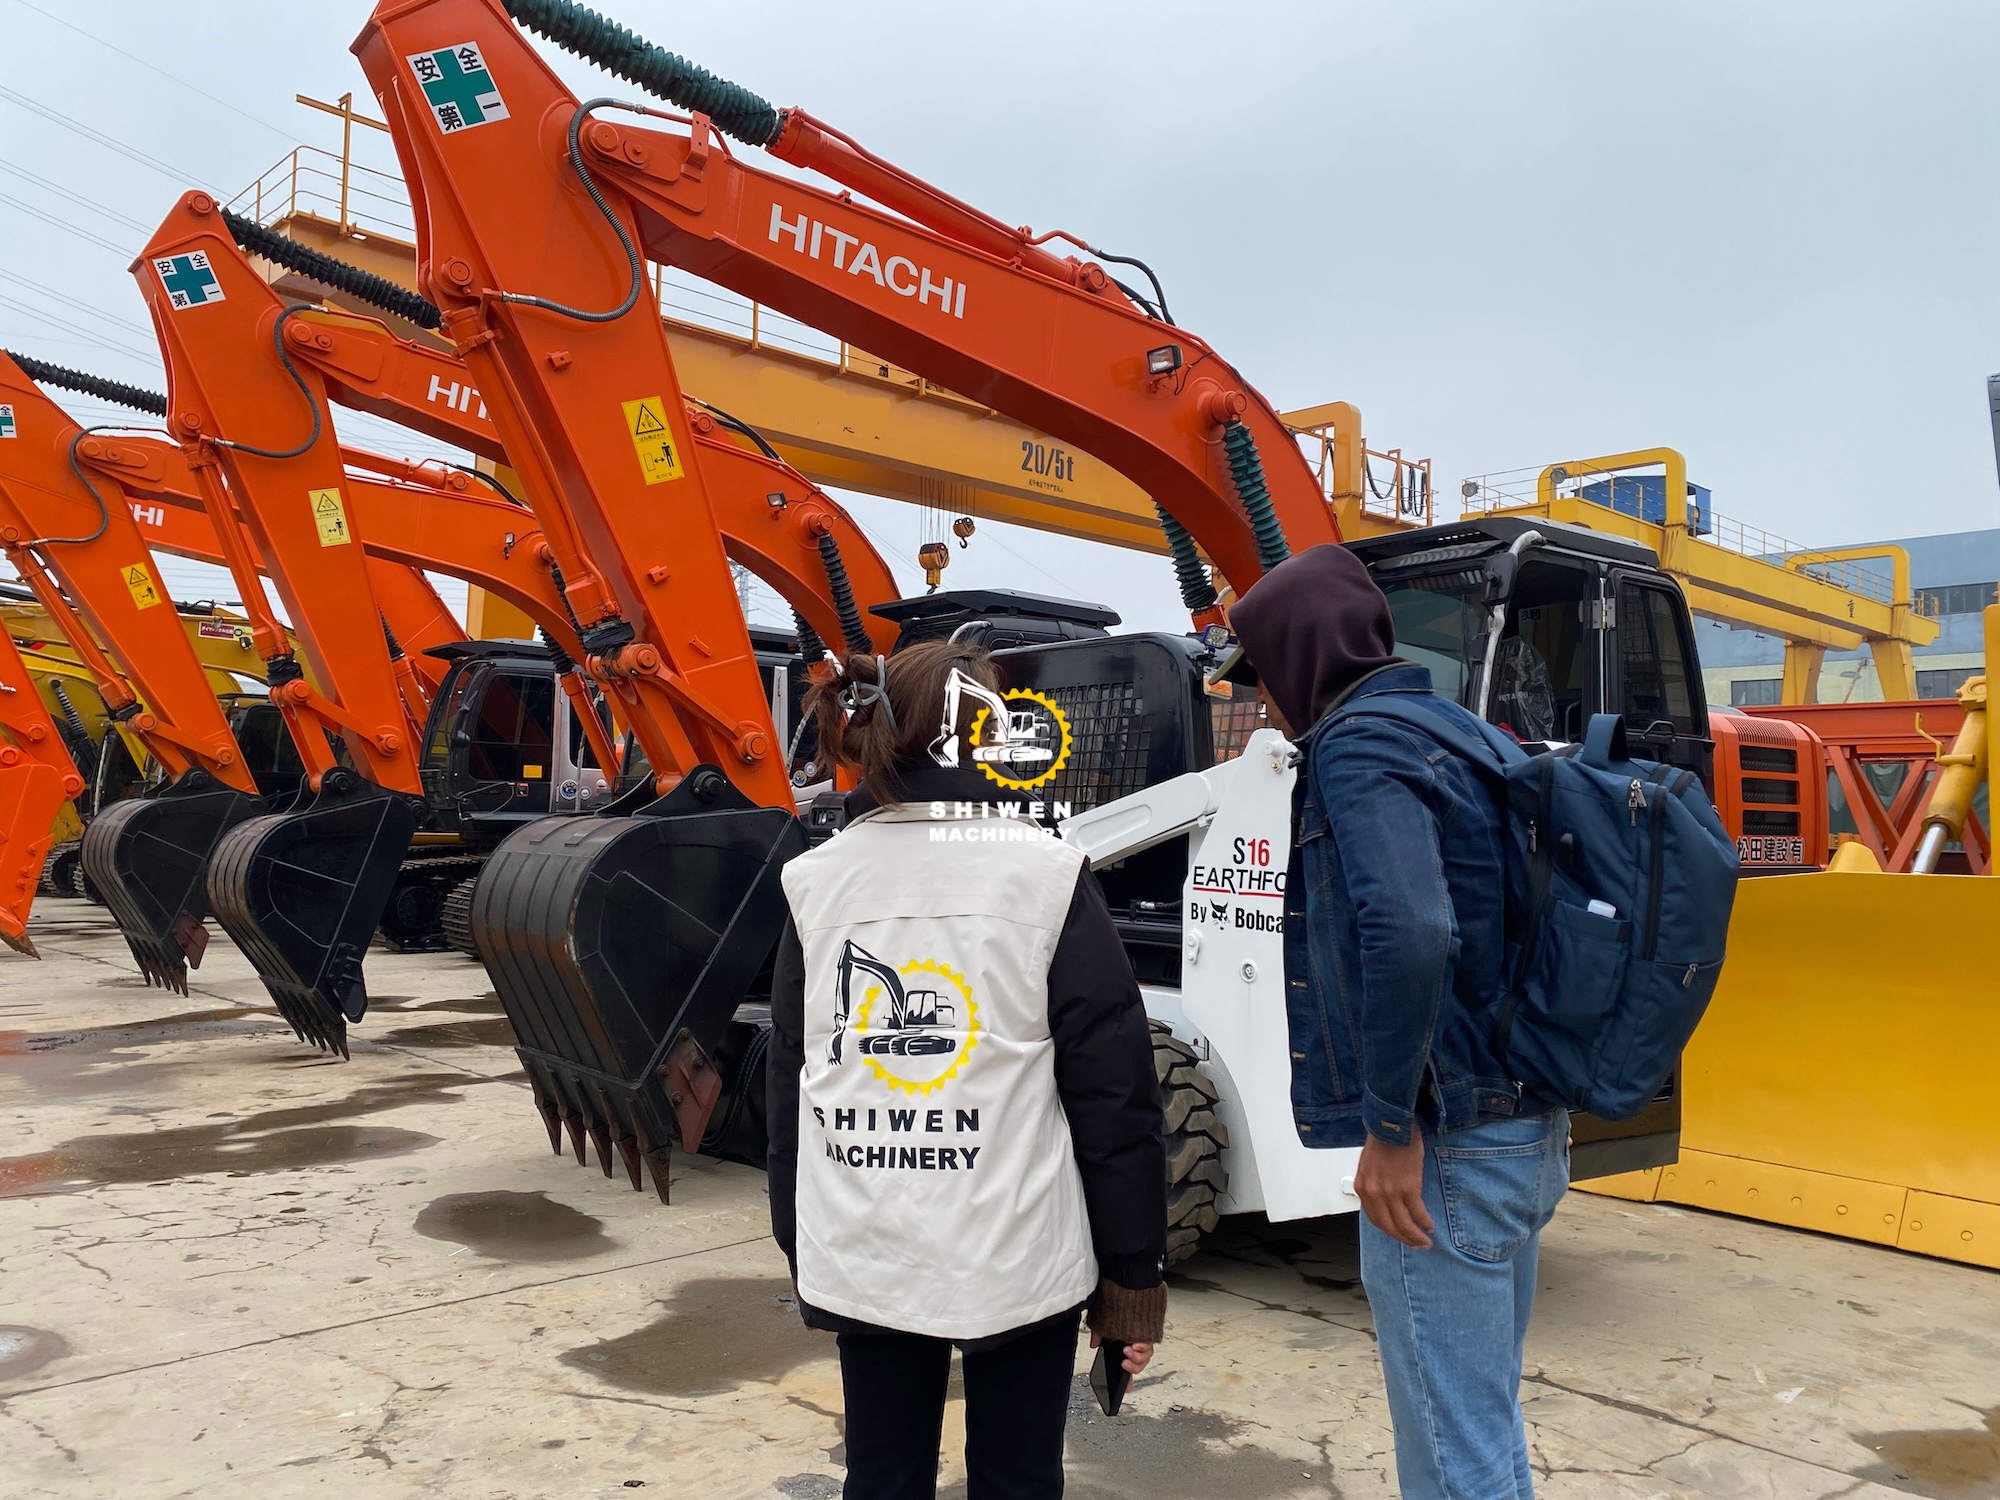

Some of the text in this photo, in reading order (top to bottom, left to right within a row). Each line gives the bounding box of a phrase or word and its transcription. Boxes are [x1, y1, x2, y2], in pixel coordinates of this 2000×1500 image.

[768, 203, 966, 319] HITACHI
[1022, 441, 1074, 482] 20/5t
[1233, 837, 1270, 867] S16
[1191, 902, 1207, 923] By
[813, 1106, 980, 1133] SHIWEN
